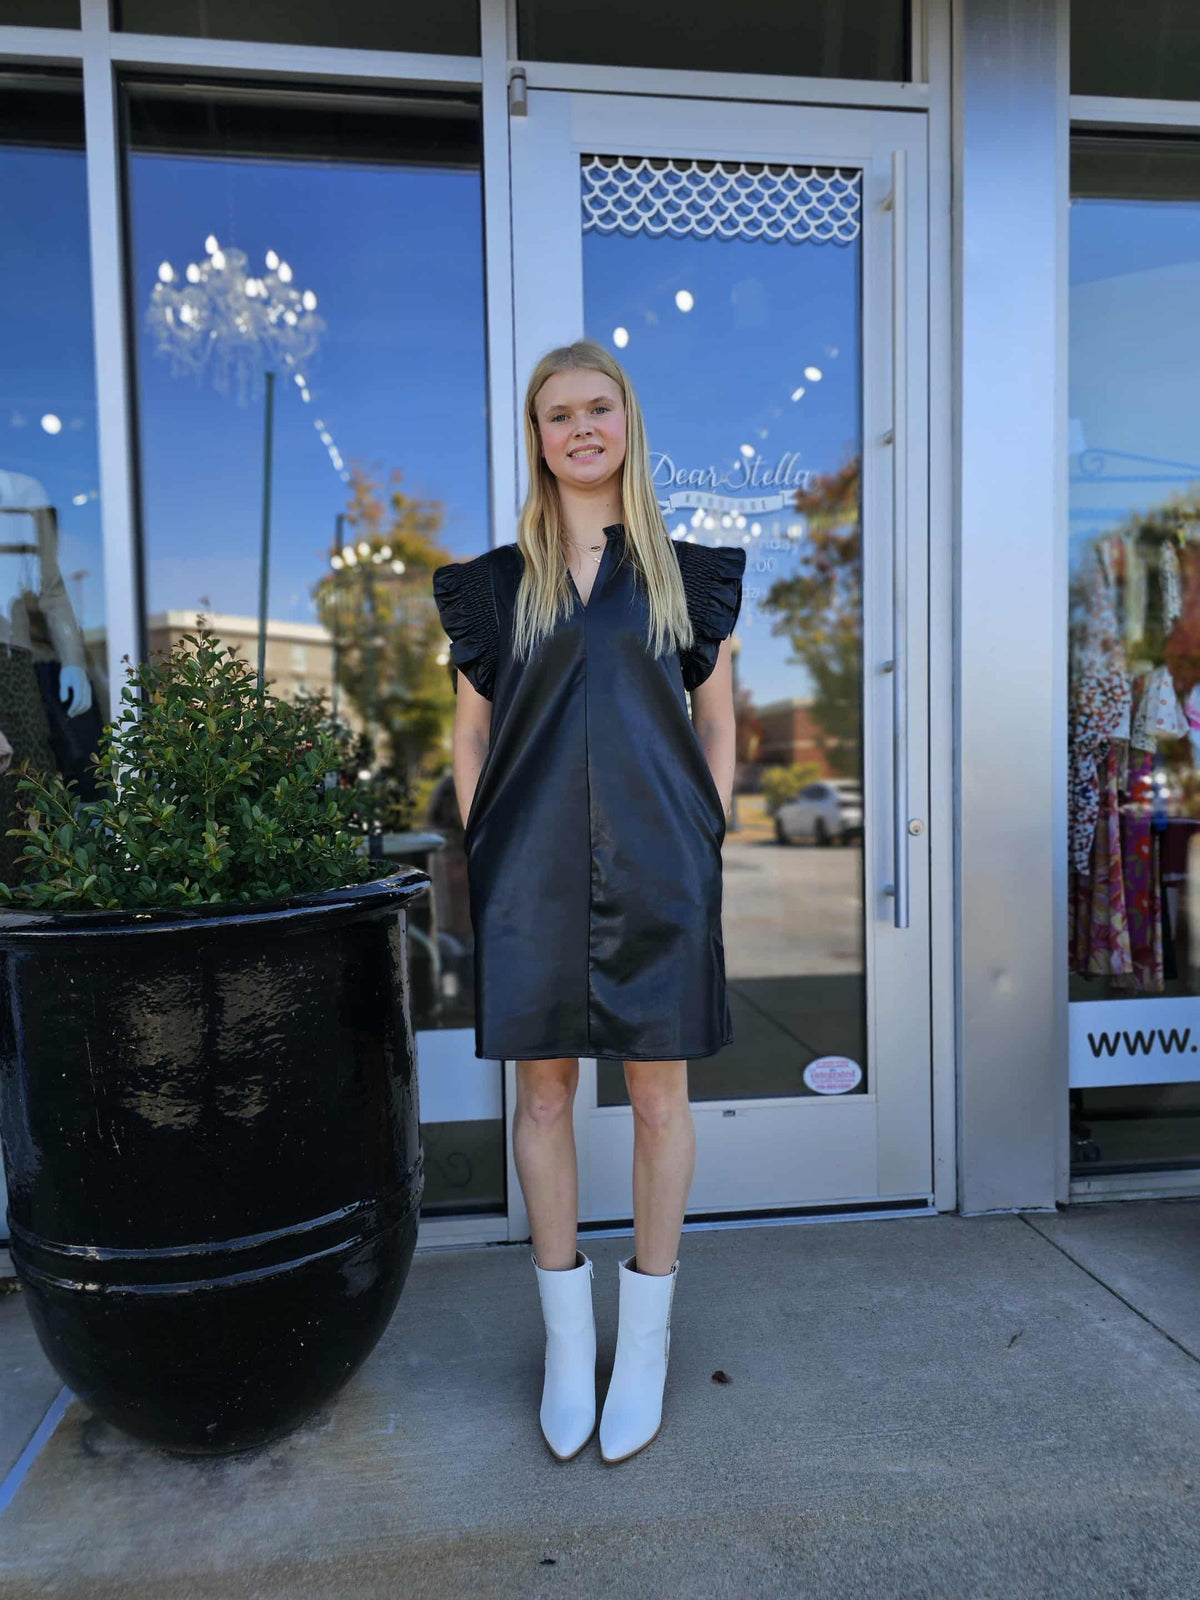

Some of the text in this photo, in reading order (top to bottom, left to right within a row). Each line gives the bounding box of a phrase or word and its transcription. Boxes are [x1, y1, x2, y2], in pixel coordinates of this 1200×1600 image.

[649, 451, 814, 489] Dear Stella
[1087, 1028, 1198, 1058] www.
